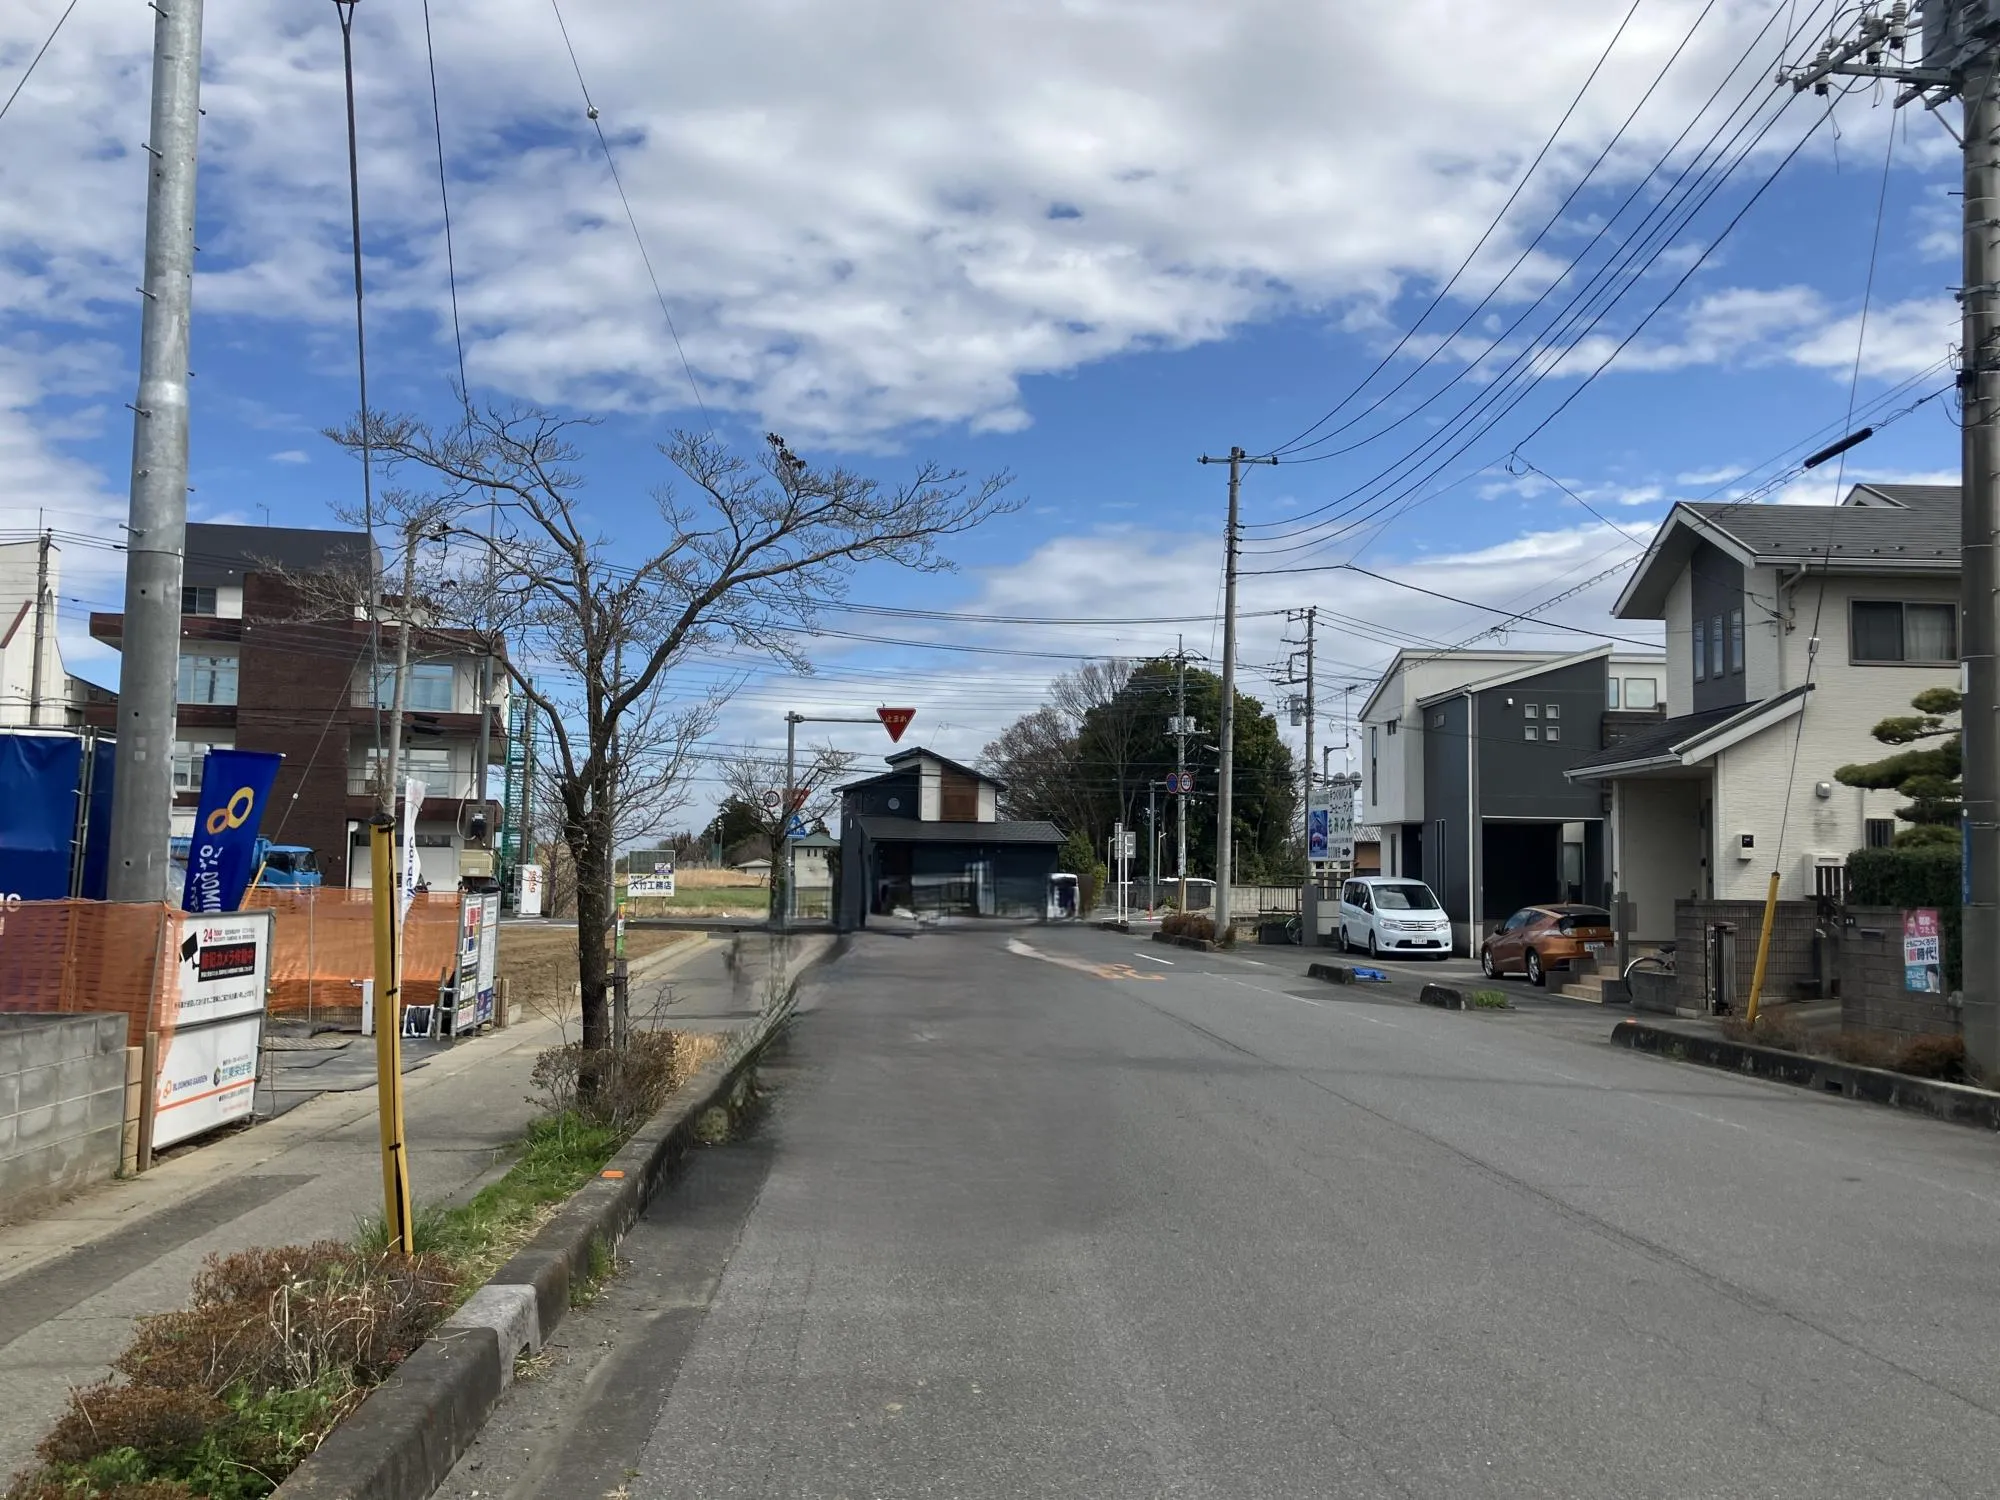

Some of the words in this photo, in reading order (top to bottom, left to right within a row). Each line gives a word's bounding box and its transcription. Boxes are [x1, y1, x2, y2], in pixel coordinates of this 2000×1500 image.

[631, 881, 672, 890] 大竹工務店
[203, 928, 213, 943] 24
